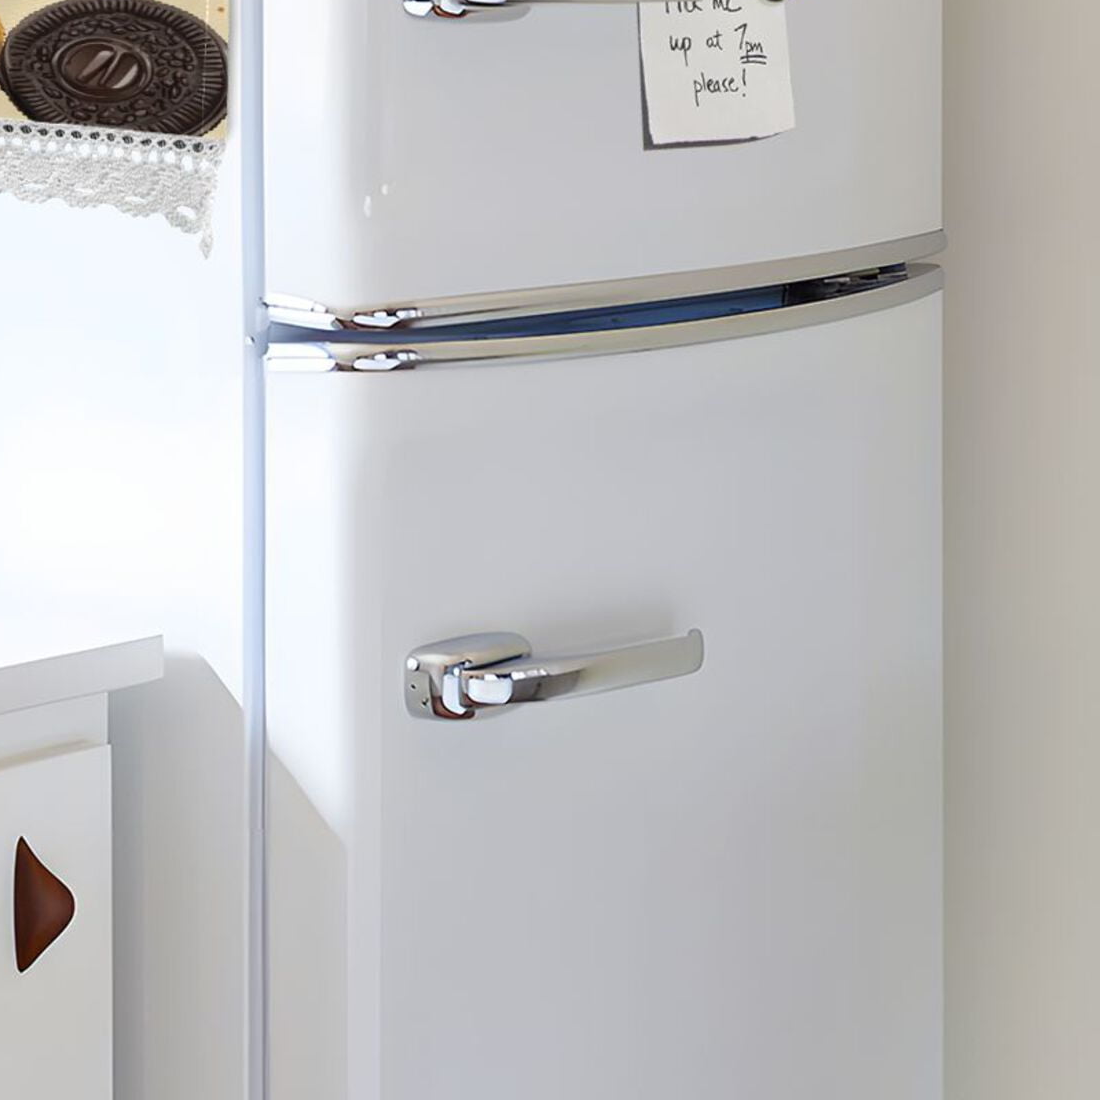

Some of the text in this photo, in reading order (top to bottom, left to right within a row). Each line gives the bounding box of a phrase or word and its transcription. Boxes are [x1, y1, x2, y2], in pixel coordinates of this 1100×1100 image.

[669, 34, 692, 67] up
[706, 29, 723, 51] at
[693, 67, 746, 107] please!
